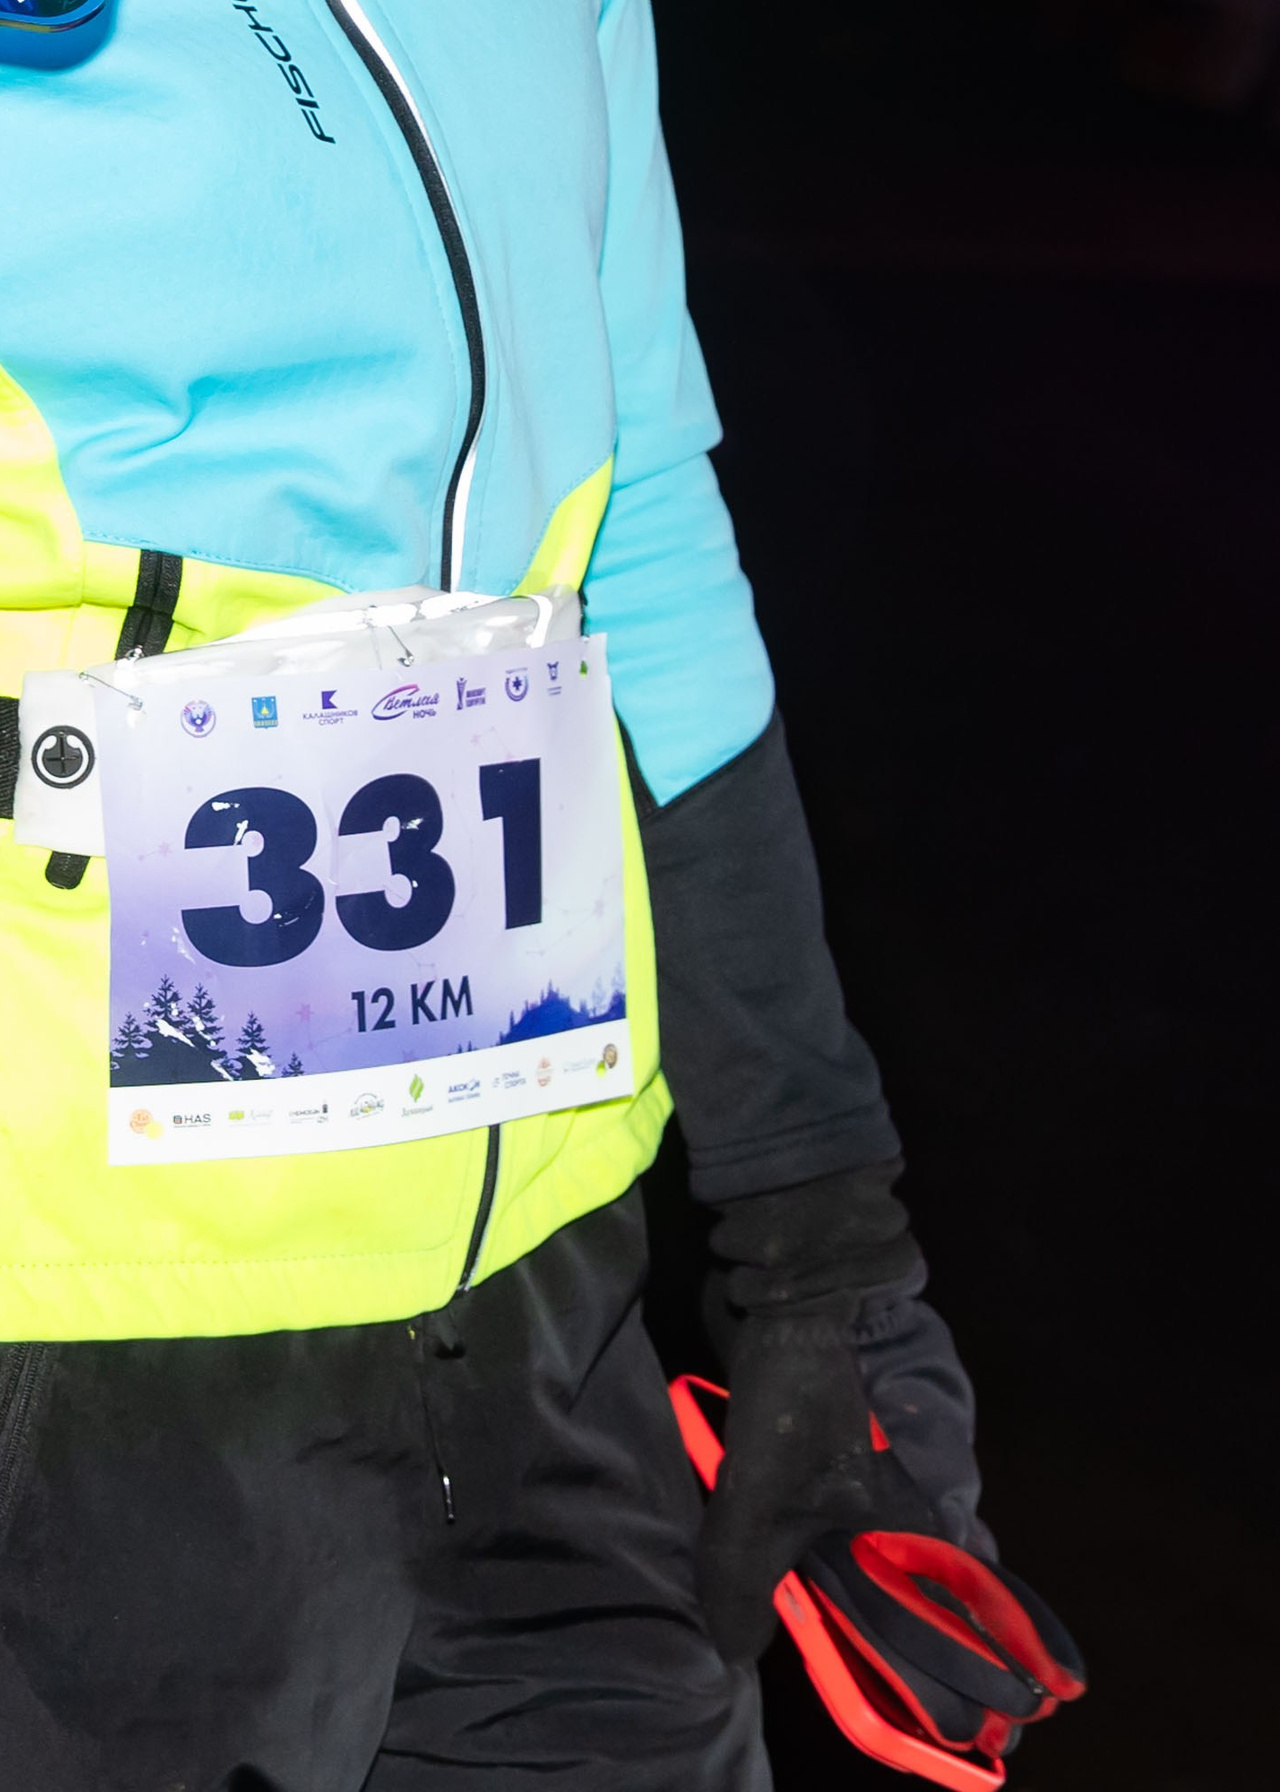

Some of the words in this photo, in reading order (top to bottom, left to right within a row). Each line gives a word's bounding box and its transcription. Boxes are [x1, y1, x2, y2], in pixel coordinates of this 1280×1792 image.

[303, 710, 359, 720] КАЛАШНИКОВ
[319, 717, 344, 726] СПОРТ
[181, 758, 542, 967] 331
[351, 987, 396, 1033] 12
[184, 1114, 211, 1124] HAS
